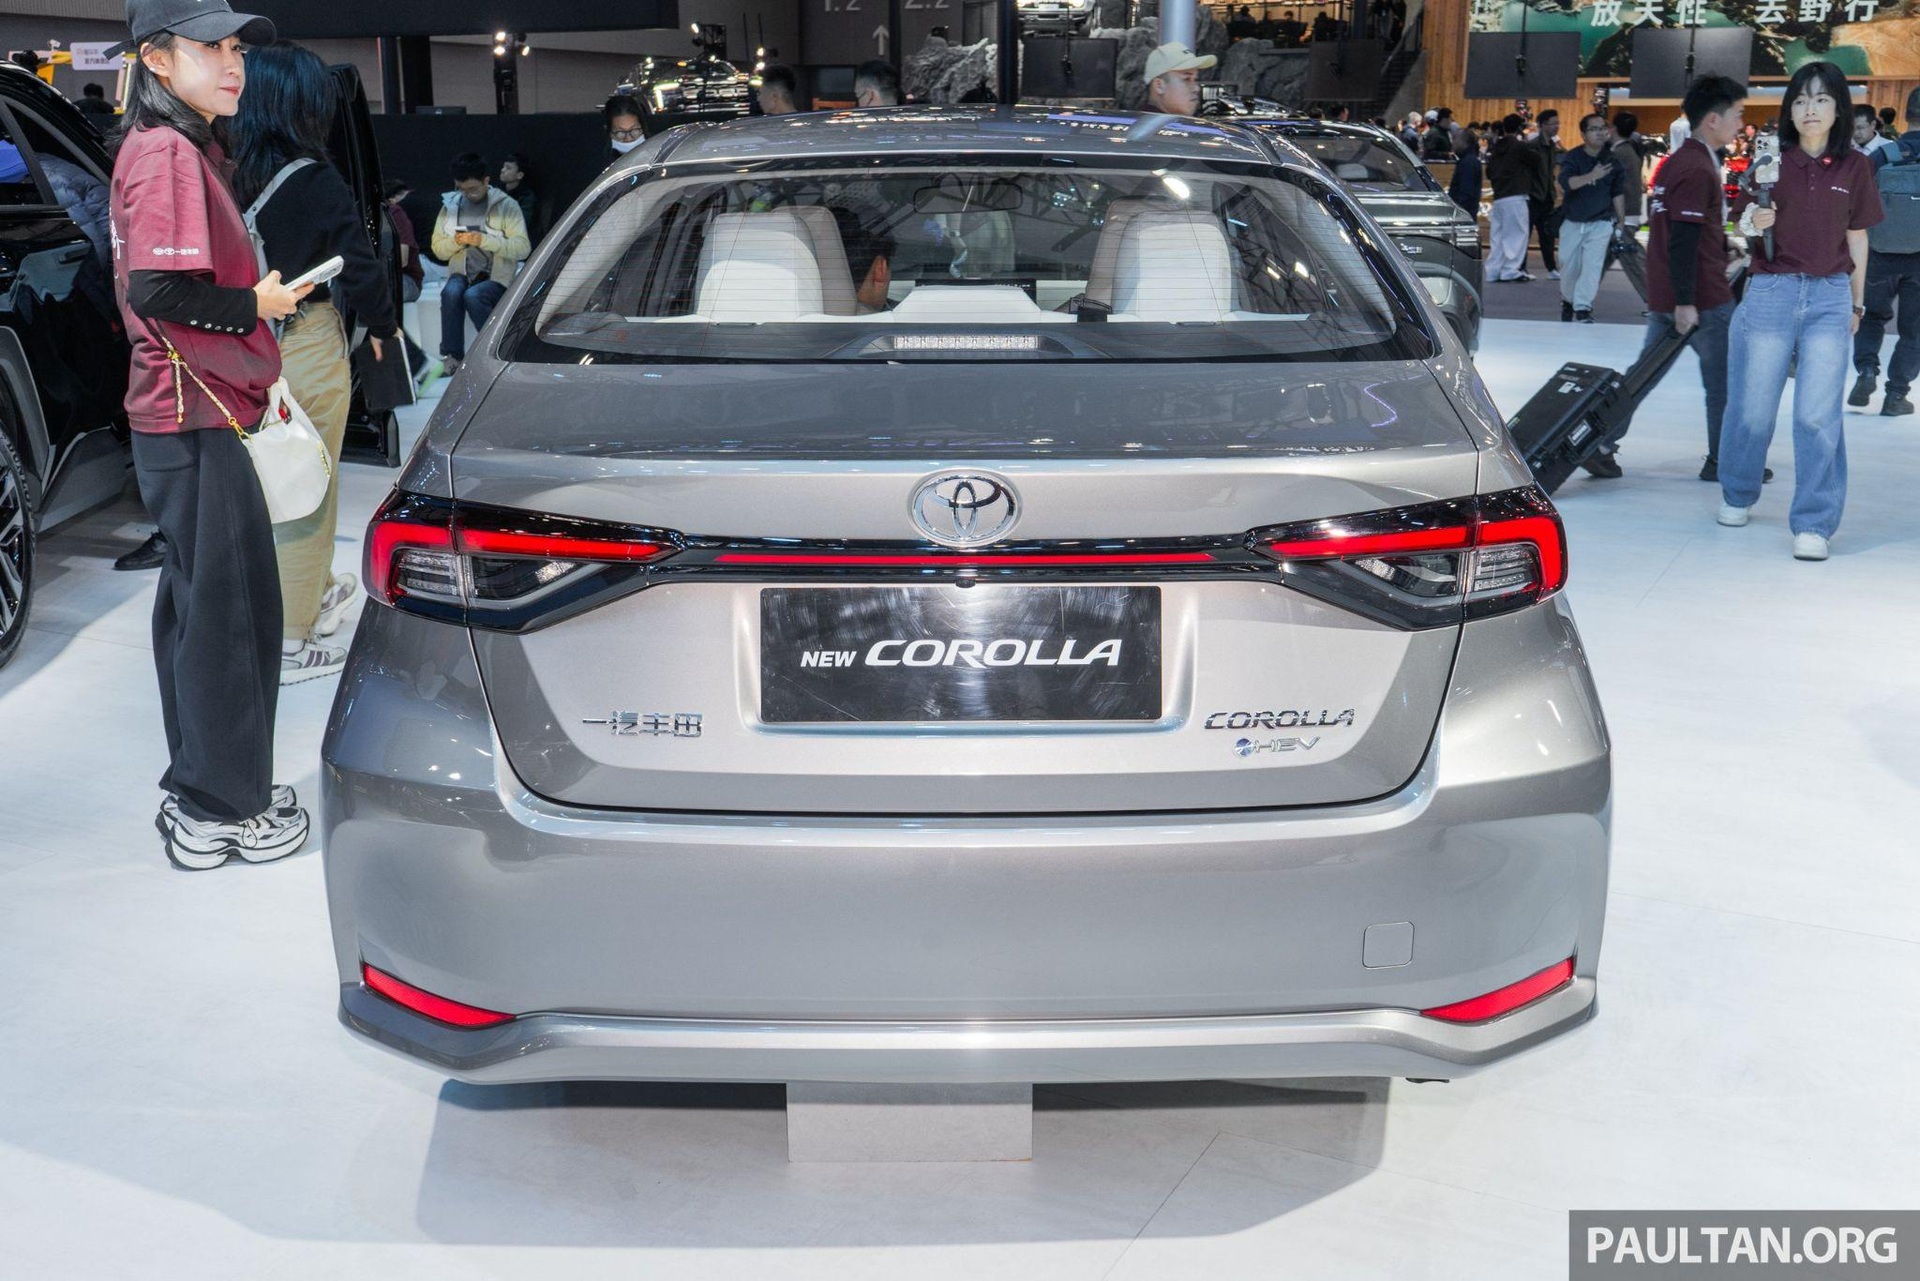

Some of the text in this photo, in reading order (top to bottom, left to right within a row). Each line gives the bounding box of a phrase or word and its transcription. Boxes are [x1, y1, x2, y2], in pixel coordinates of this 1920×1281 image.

[1590, 0, 1879, 27] 放天性 去野行
[800, 638, 1122, 669] NEW COROLLA
[582, 710, 703, 737] 一汽丰田
[1204, 708, 1355, 730] COROLLA
[1255, 736, 1321, 753] HEV
